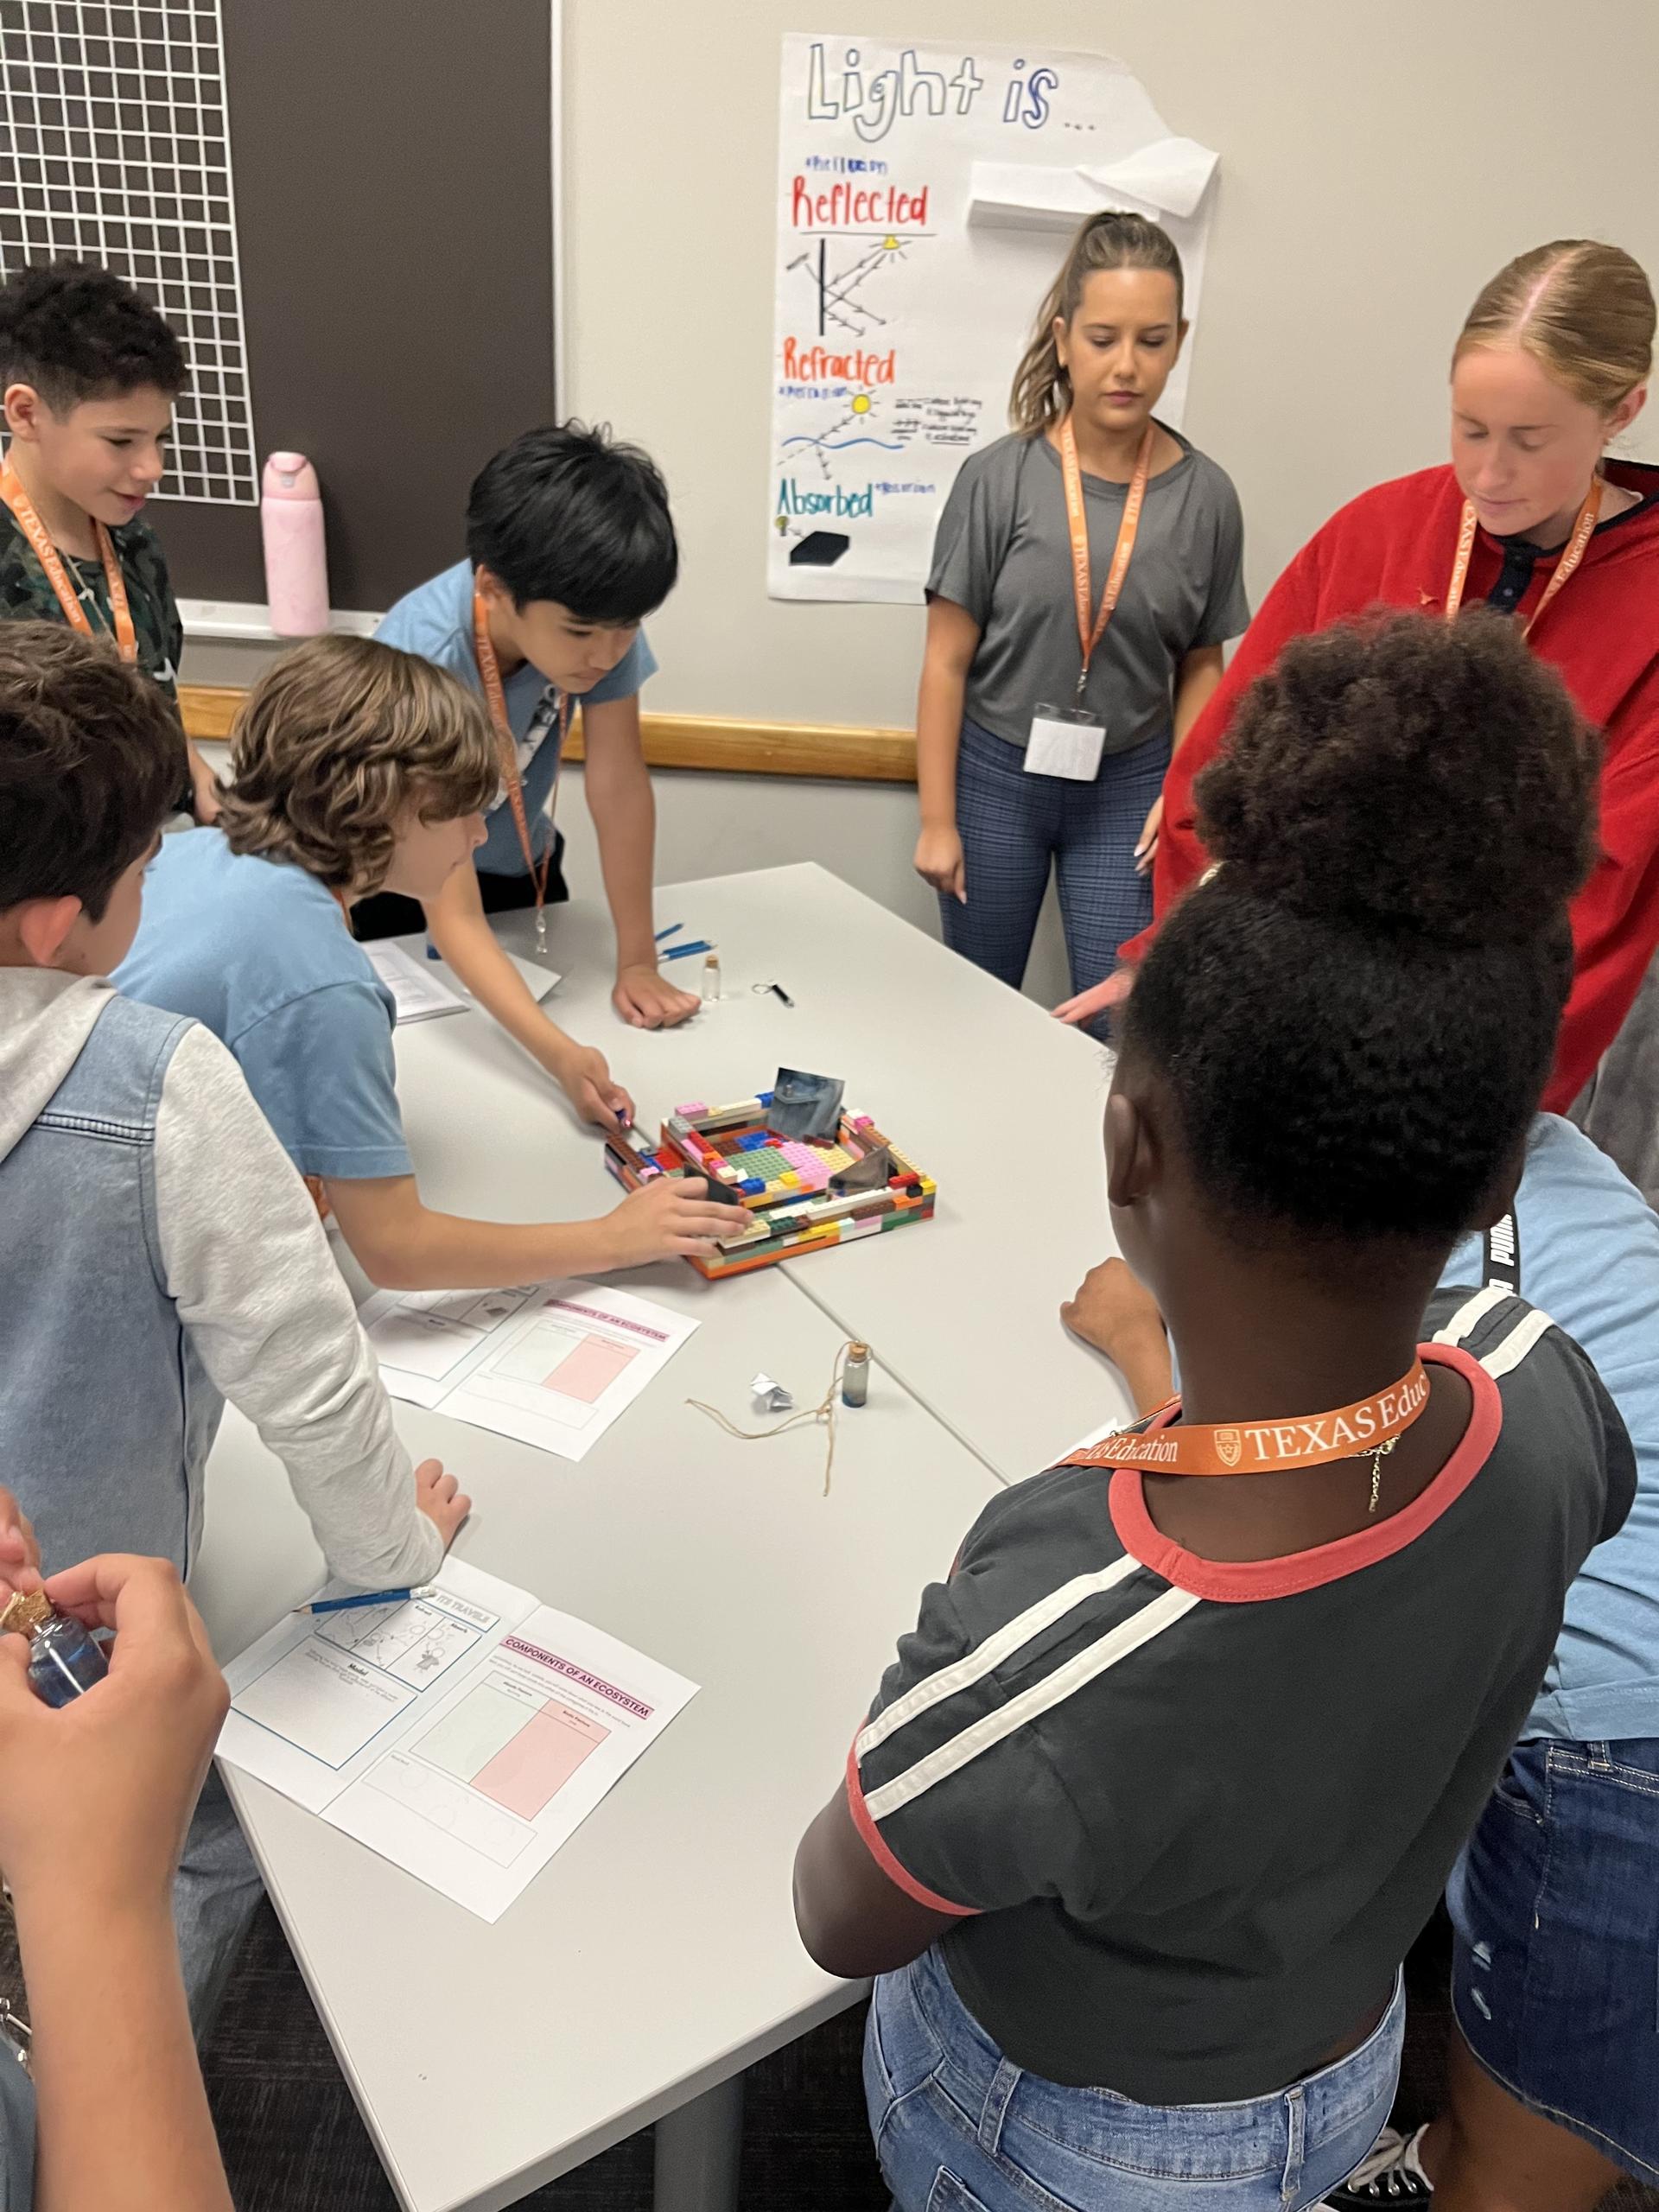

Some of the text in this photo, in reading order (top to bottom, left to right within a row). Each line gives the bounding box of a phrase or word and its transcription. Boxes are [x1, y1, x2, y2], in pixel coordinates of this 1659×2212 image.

[808, 44, 982, 142] Light
[792, 175, 929, 226] Reflected
[784, 336, 895, 386] Refracted
[778, 478, 874, 518] Absorbed
[21, 505, 81, 622] TEXAS Education
[1555, 512, 1595, 582] Education
[1244, 1405, 1376, 1461] TEXAS
[347, 1662, 369, 1676] Model
[505, 1638, 649, 1717] COMPONENTS OF AN ECOSYSTEM
